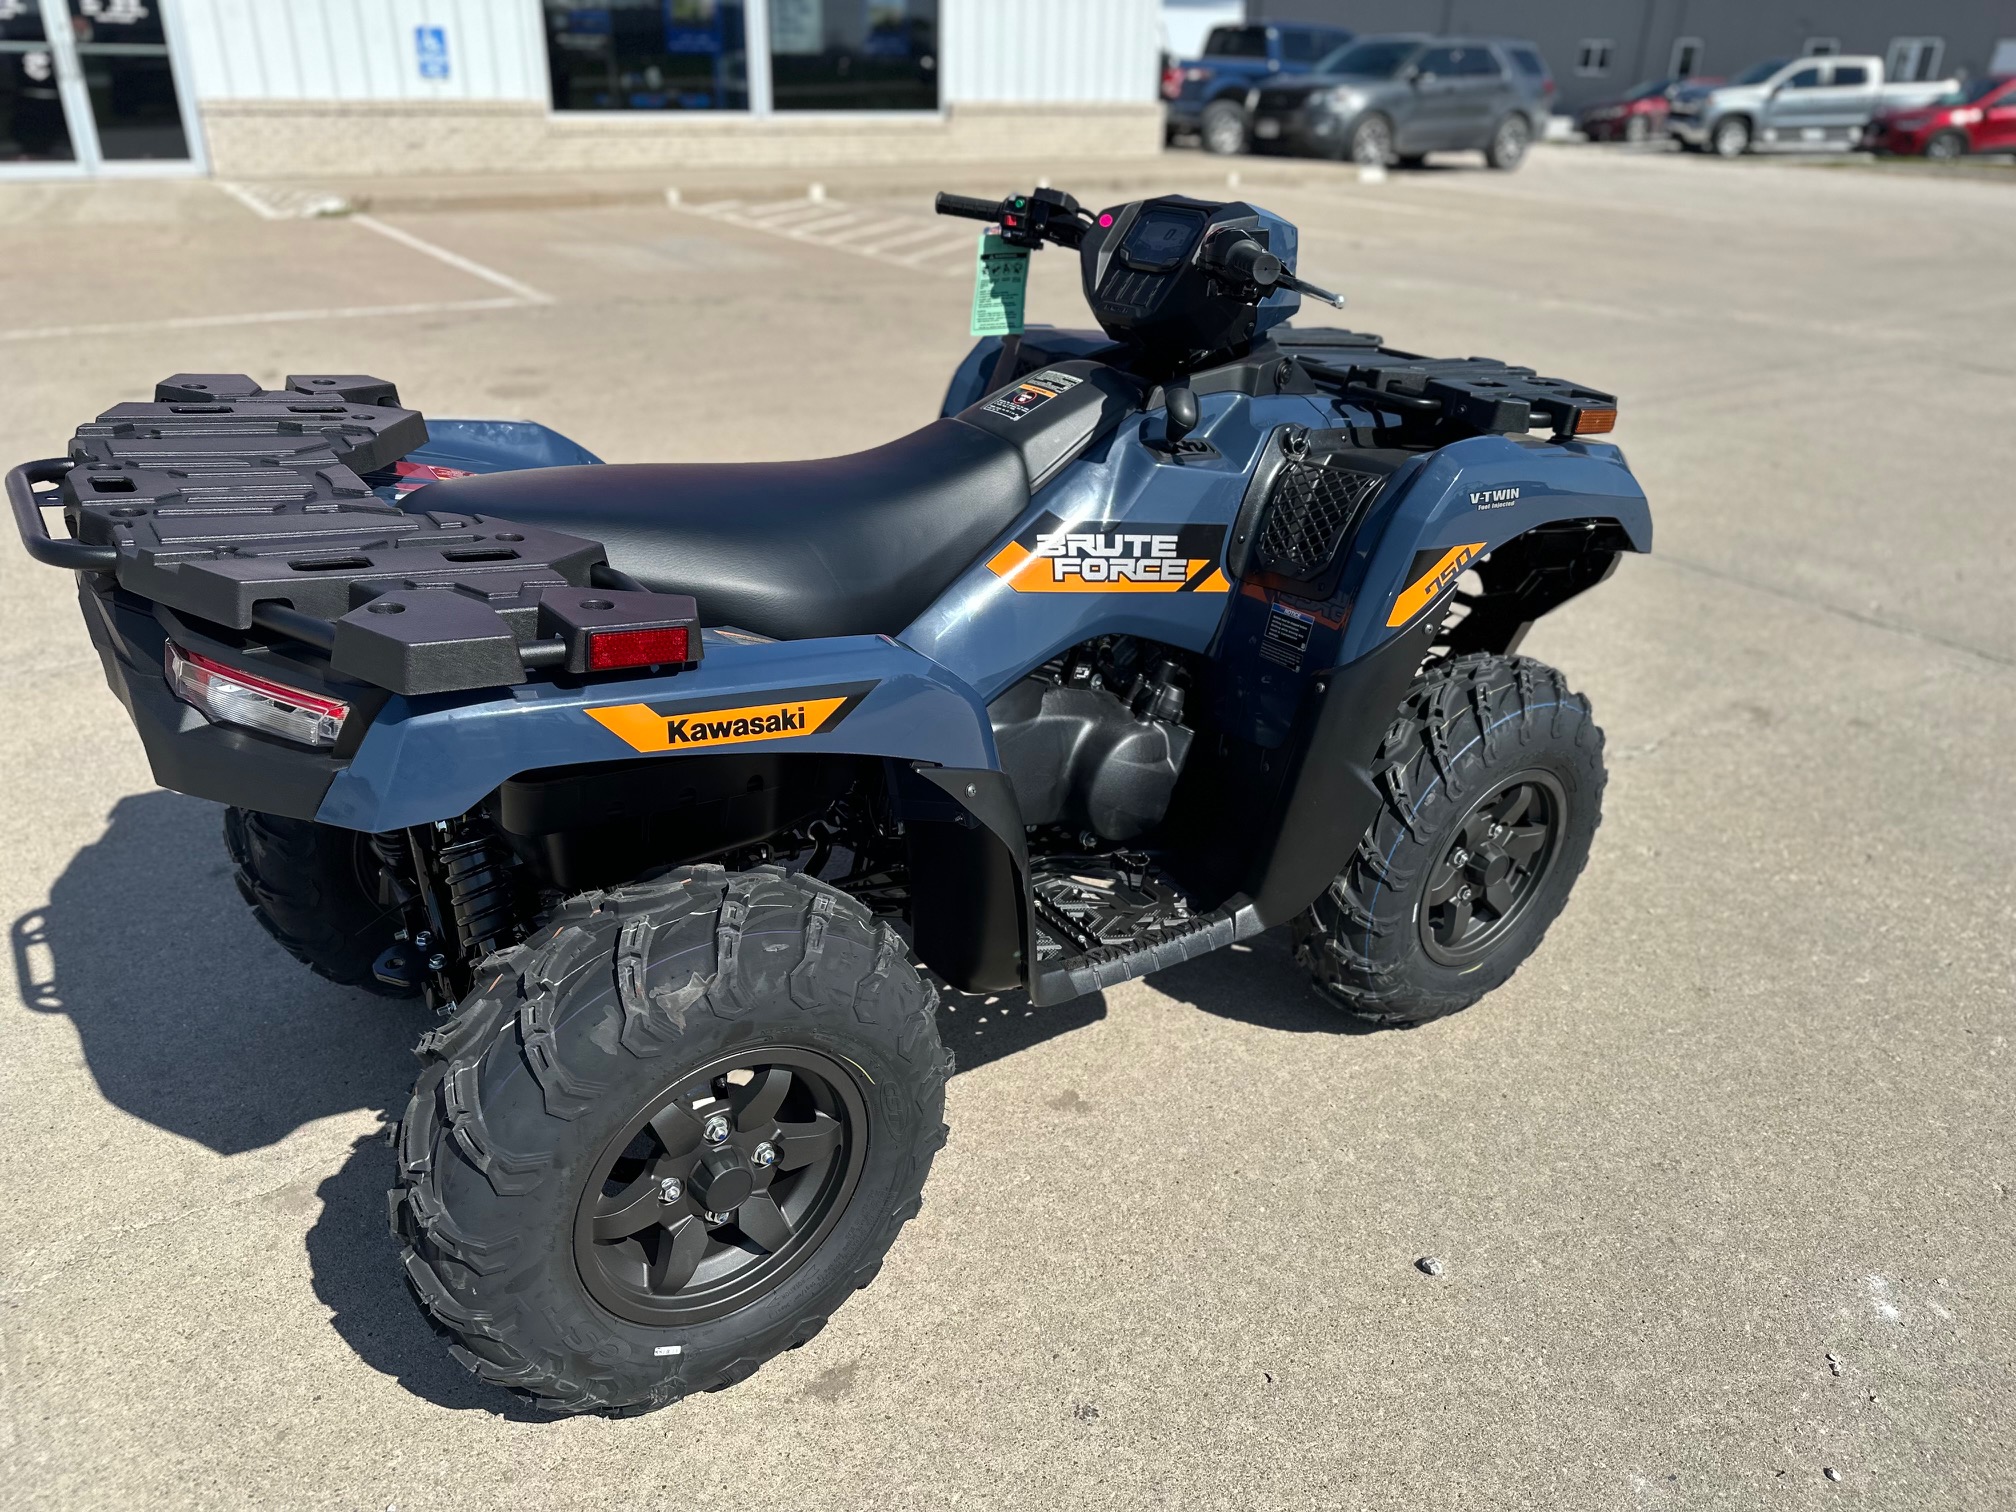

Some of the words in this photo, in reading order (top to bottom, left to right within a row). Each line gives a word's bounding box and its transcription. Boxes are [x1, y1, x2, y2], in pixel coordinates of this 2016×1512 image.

[1469, 487, 1520, 504] V-TWIN
[1036, 533, 1179, 558] BRUTE
[1053, 557, 1188, 582] FORCE
[667, 706, 806, 744] Kawasaki
